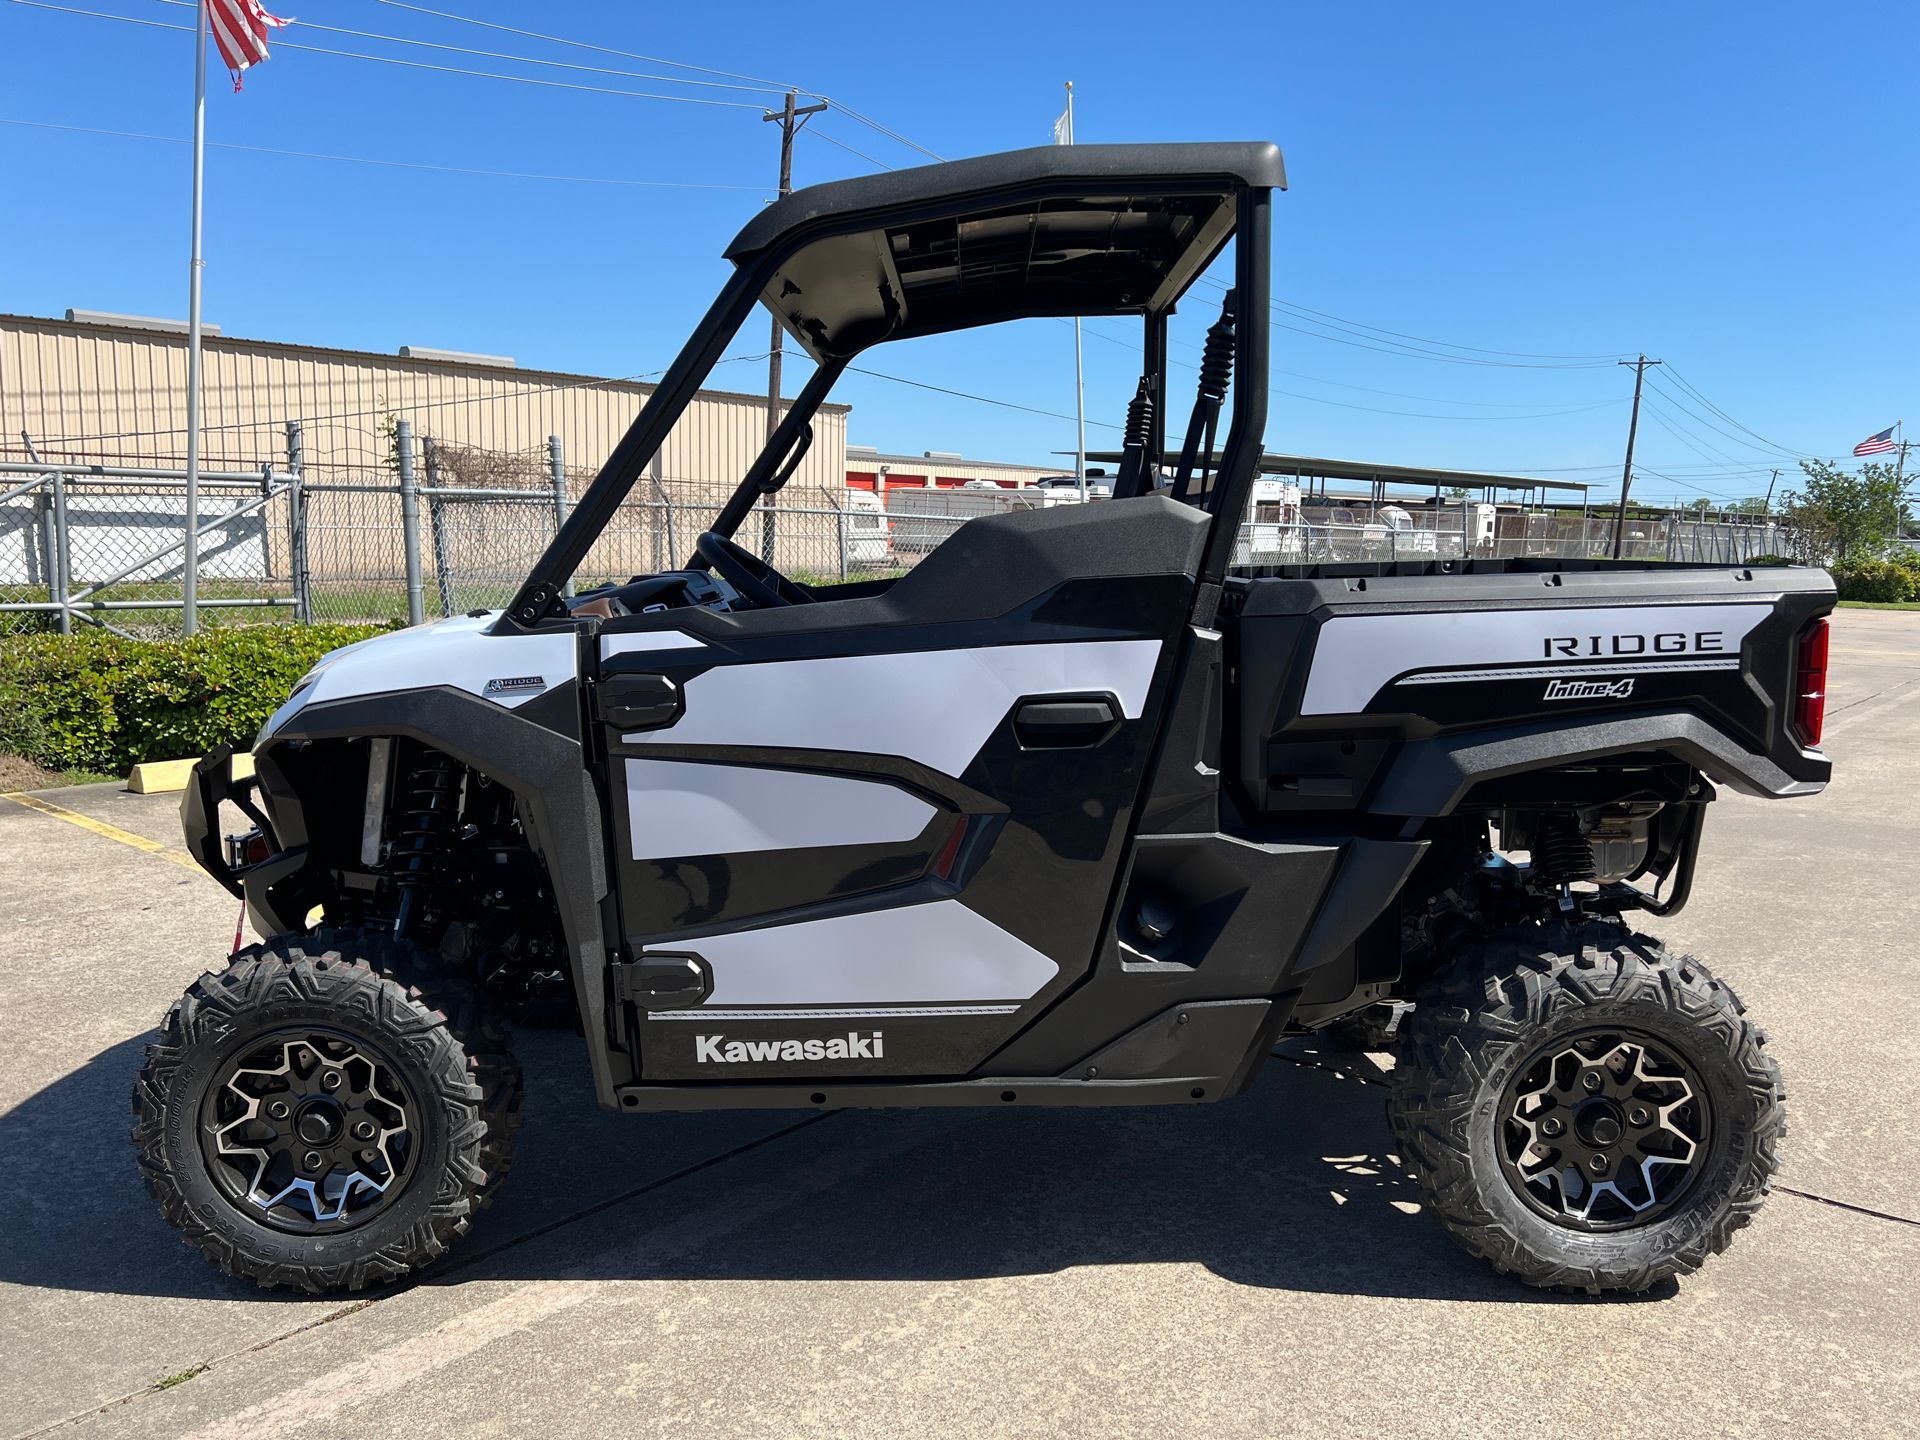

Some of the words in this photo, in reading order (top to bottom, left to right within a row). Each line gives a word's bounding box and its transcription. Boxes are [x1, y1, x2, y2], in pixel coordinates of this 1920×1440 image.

[1544, 632, 1723, 657] RIDGE
[504, 677, 542, 685] RIDGE
[1543, 679, 1635, 700] Inline-4
[695, 1031, 884, 1063] Kawasaki
